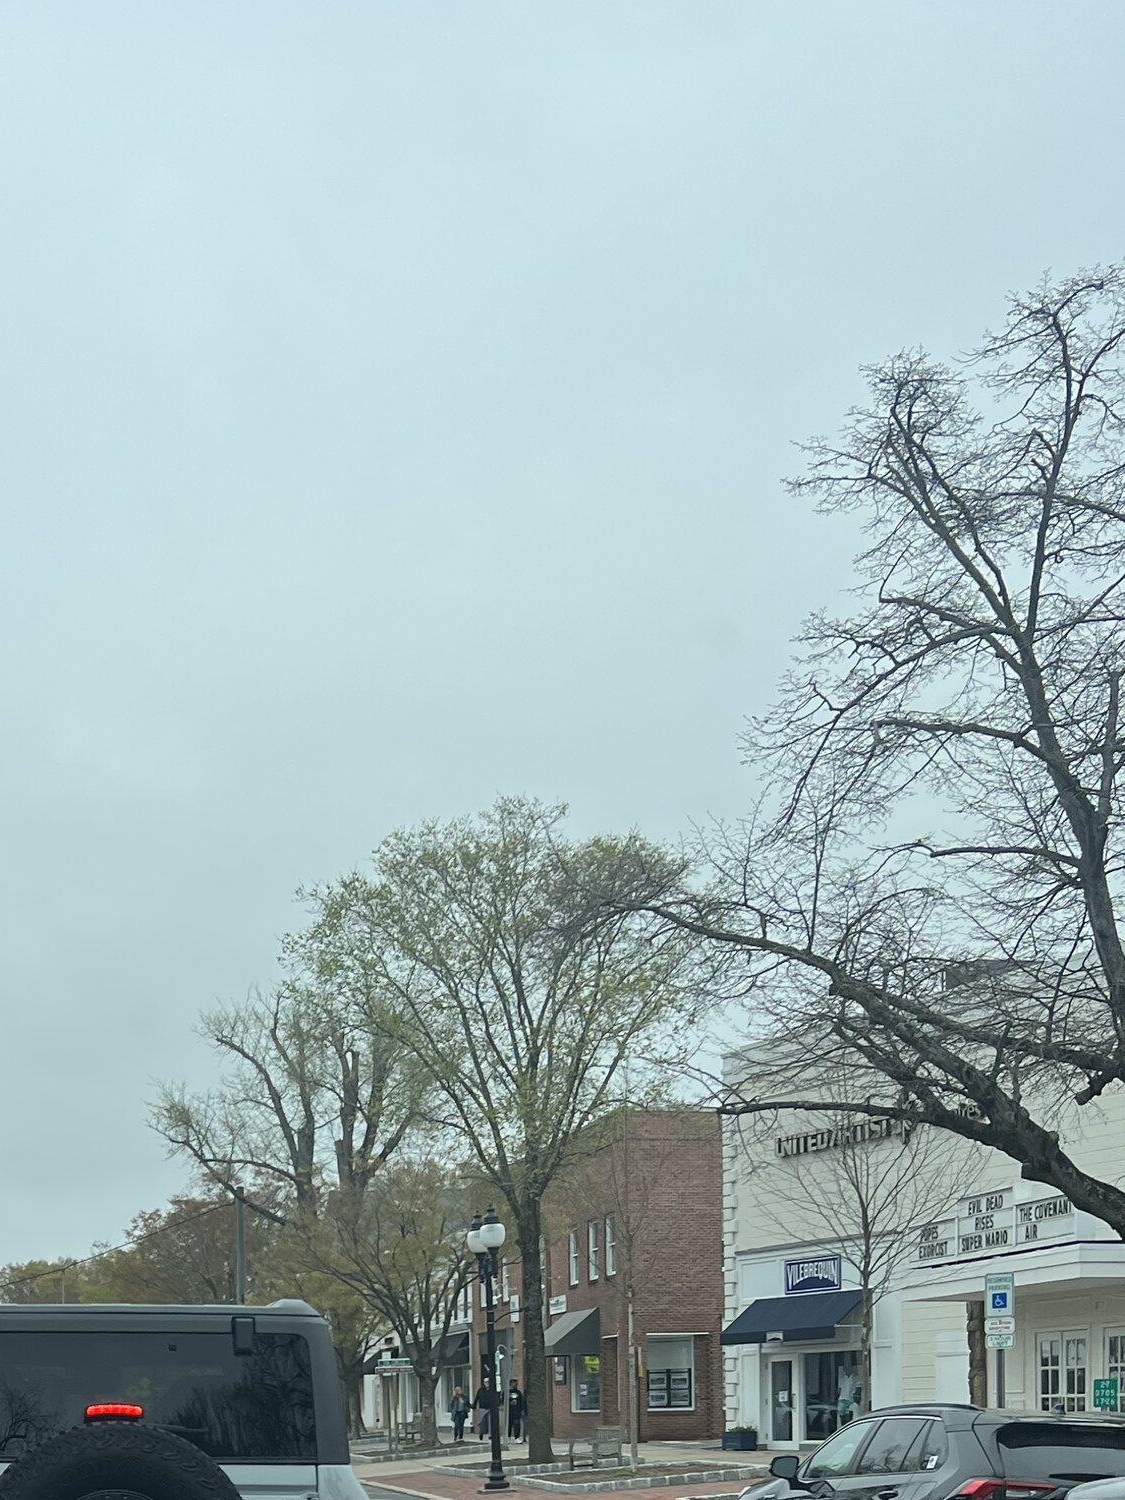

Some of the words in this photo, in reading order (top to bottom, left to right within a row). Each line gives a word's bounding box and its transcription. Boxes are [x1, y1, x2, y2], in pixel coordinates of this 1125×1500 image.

[968, 1201, 982, 1215] EVIL
[986, 1195, 1003, 1211] DEAD
[975, 1214, 994, 1230] RISES
[1019, 1207, 1032, 1222] THE
[961, 1235, 982, 1251] SUPER
[985, 1230, 1008, 1248] MARIO
[1025, 1224, 1038, 1240] AIR
[919, 1241, 948, 1259] EXORCIST
[787, 1259, 838, 1290] VILEBREQUIN
